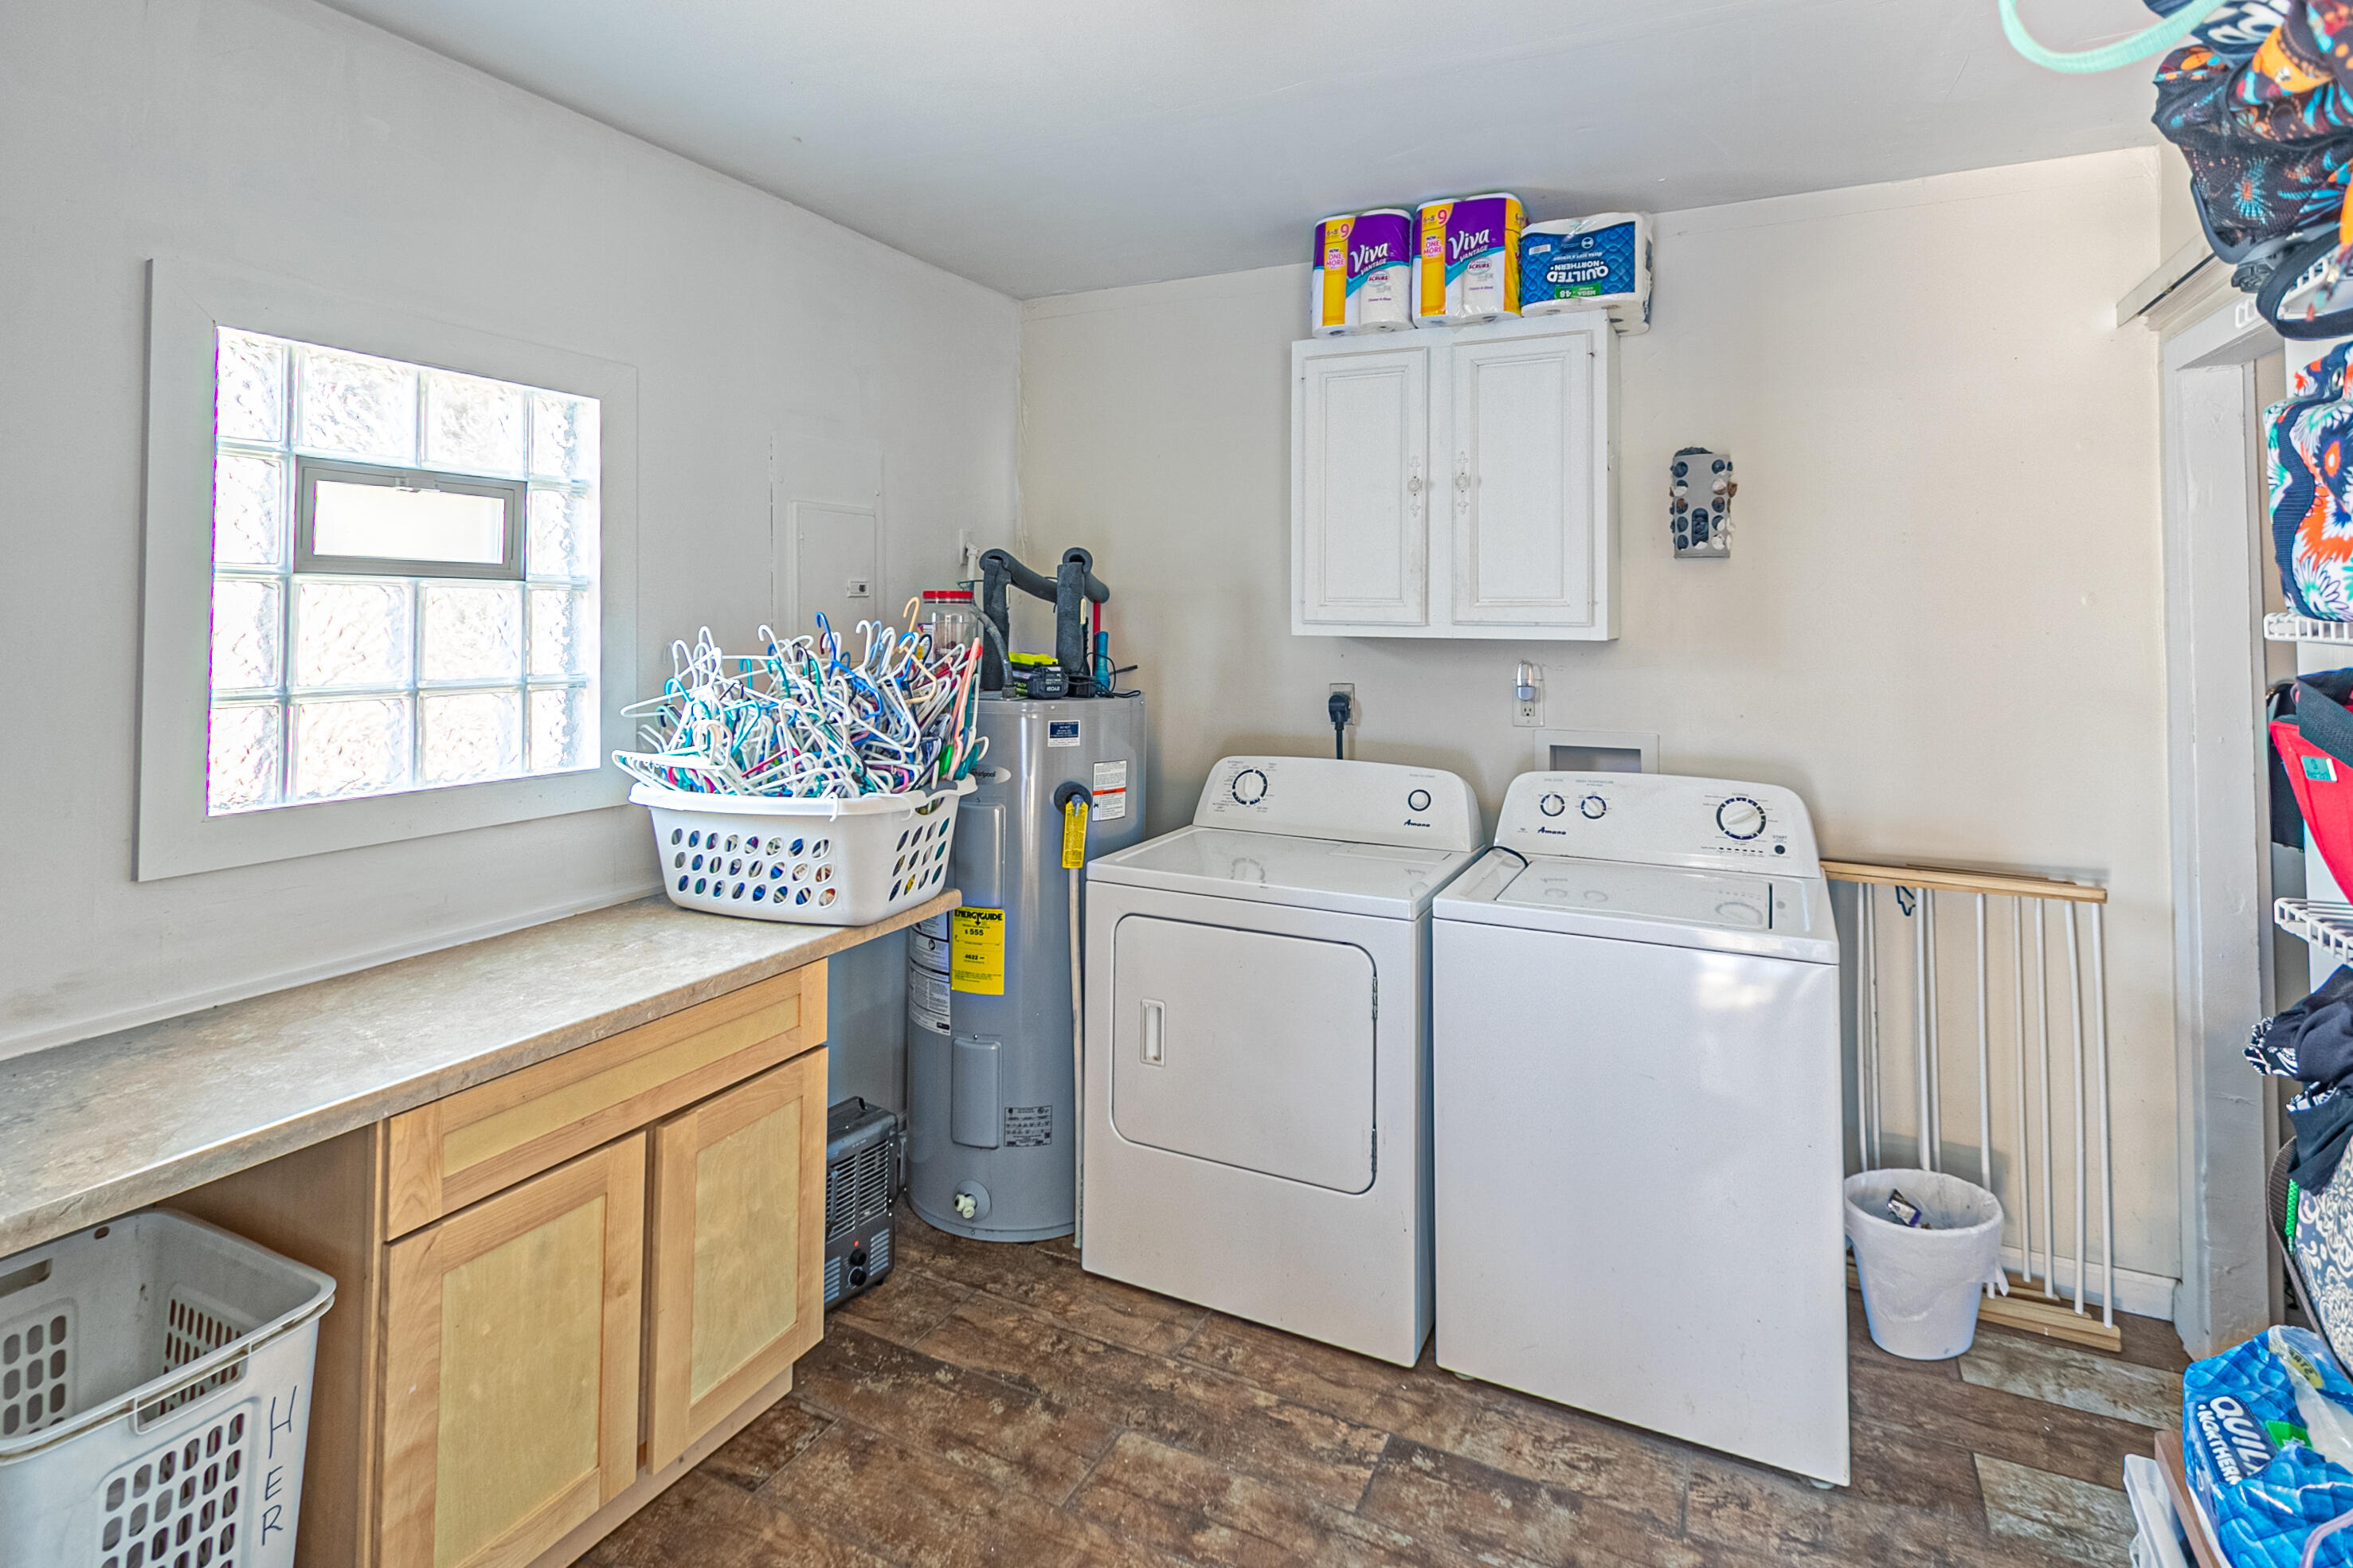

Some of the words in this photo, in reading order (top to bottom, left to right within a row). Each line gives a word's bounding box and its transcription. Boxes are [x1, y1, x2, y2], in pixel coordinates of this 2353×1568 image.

[1437, 209, 1448, 225] 9
[1340, 223, 1350, 239] 9
[1423, 246, 1443, 255] MORE
[1447, 229, 1490, 260] Viva
[1349, 243, 1389, 273] Viva
[1459, 244, 1489, 263] VANTAGE
[1361, 257, 1388, 276] VANTAGE
[1555, 260, 1599, 271] NORTHERN
[1547, 265, 1609, 283] QUILTED
[1560, 289, 1572, 298] 48
[1404, 819, 1431, 827] Amana
[1537, 827, 1567, 835] Amana
[954, 909, 1003, 921] ENERGYGUIDE
[969, 928, 984, 936] 555
[260, 1384, 298, 1546] HER
